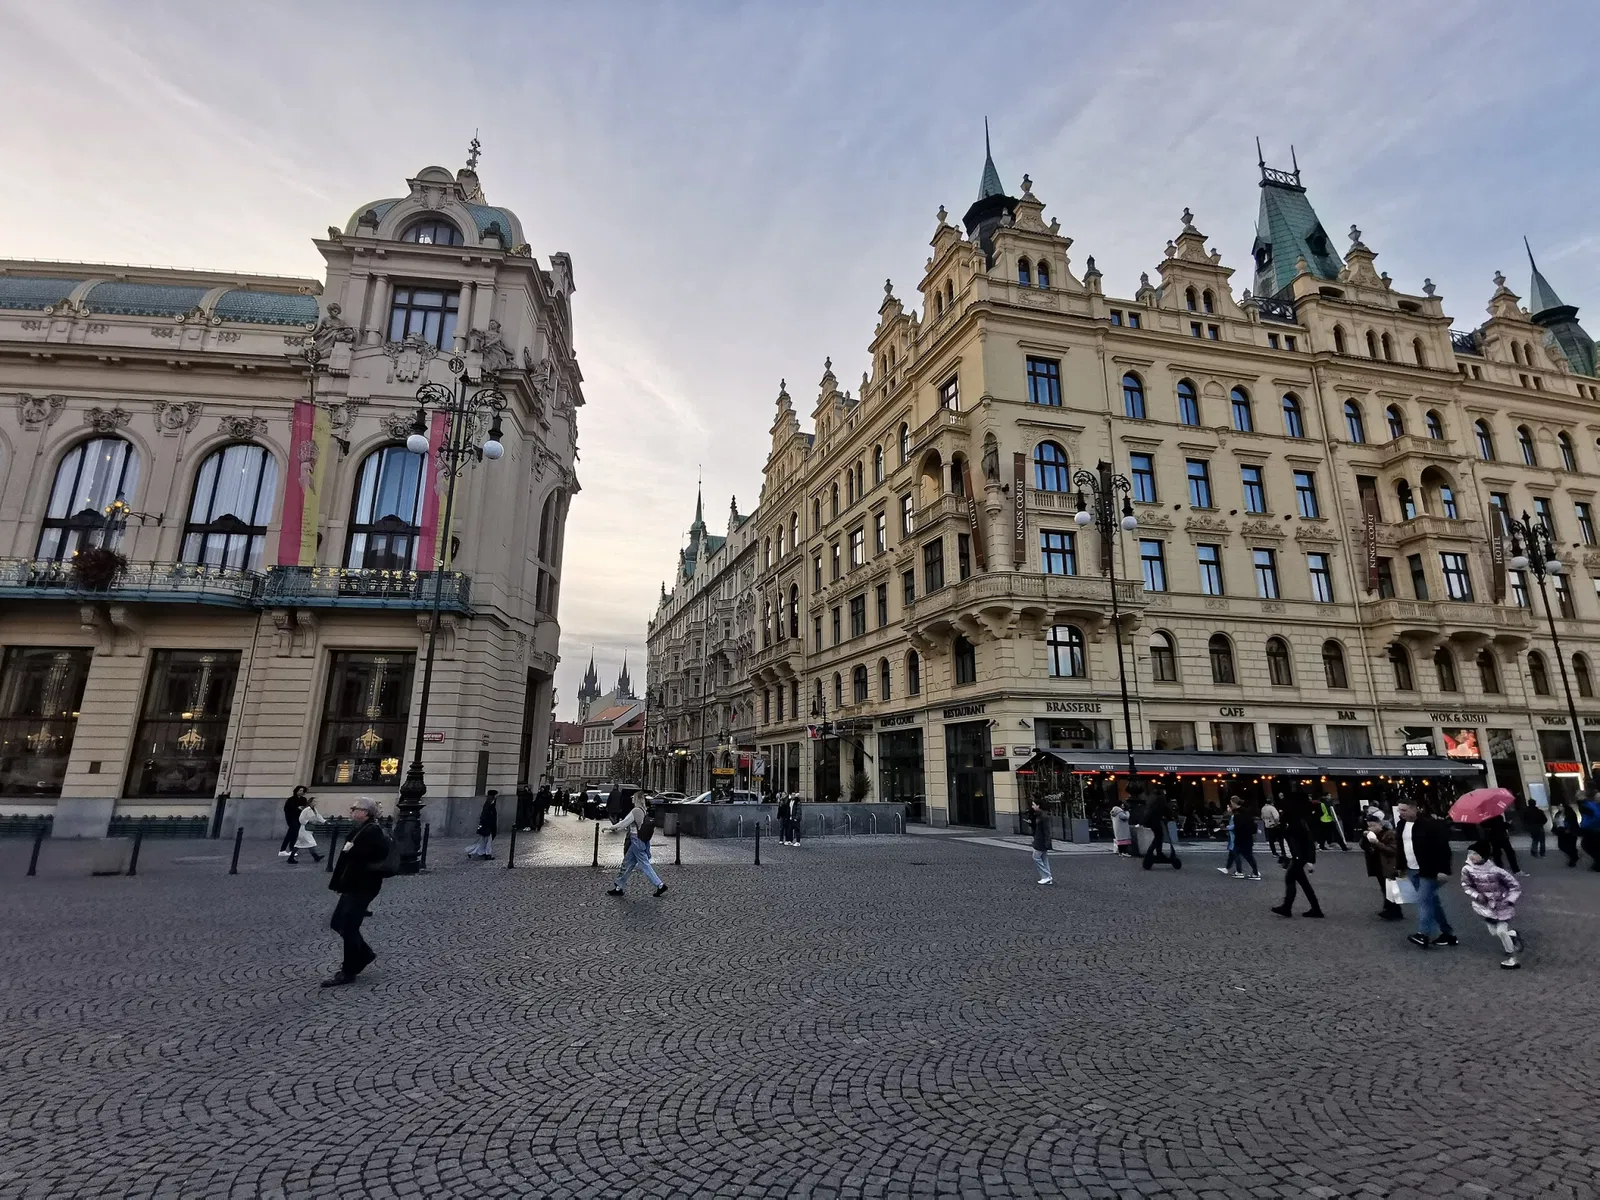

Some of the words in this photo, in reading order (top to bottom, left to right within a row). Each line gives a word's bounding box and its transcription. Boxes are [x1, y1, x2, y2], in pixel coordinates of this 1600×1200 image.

[1016, 479, 1024, 509] COURT
[968, 497, 978, 529] HOTEL
[1016, 511, 1024, 540] KINGS
[1367, 513, 1375, 540] COURT
[1494, 536, 1503, 564] HOTEL
[943, 704, 986, 719] RESTAURANT
[1046, 702, 1102, 713] BRASSERIE
[1219, 707, 1245, 717] CAFE
[1337, 710, 1357, 720] BAR
[1429, 713, 1452, 722] WOK
[1453, 713, 1461, 722] &
[1462, 714, 1488, 723] SUSHI
[1541, 716, 1567, 726] VEGAS
[1547, 762, 1580, 772] CASINO
